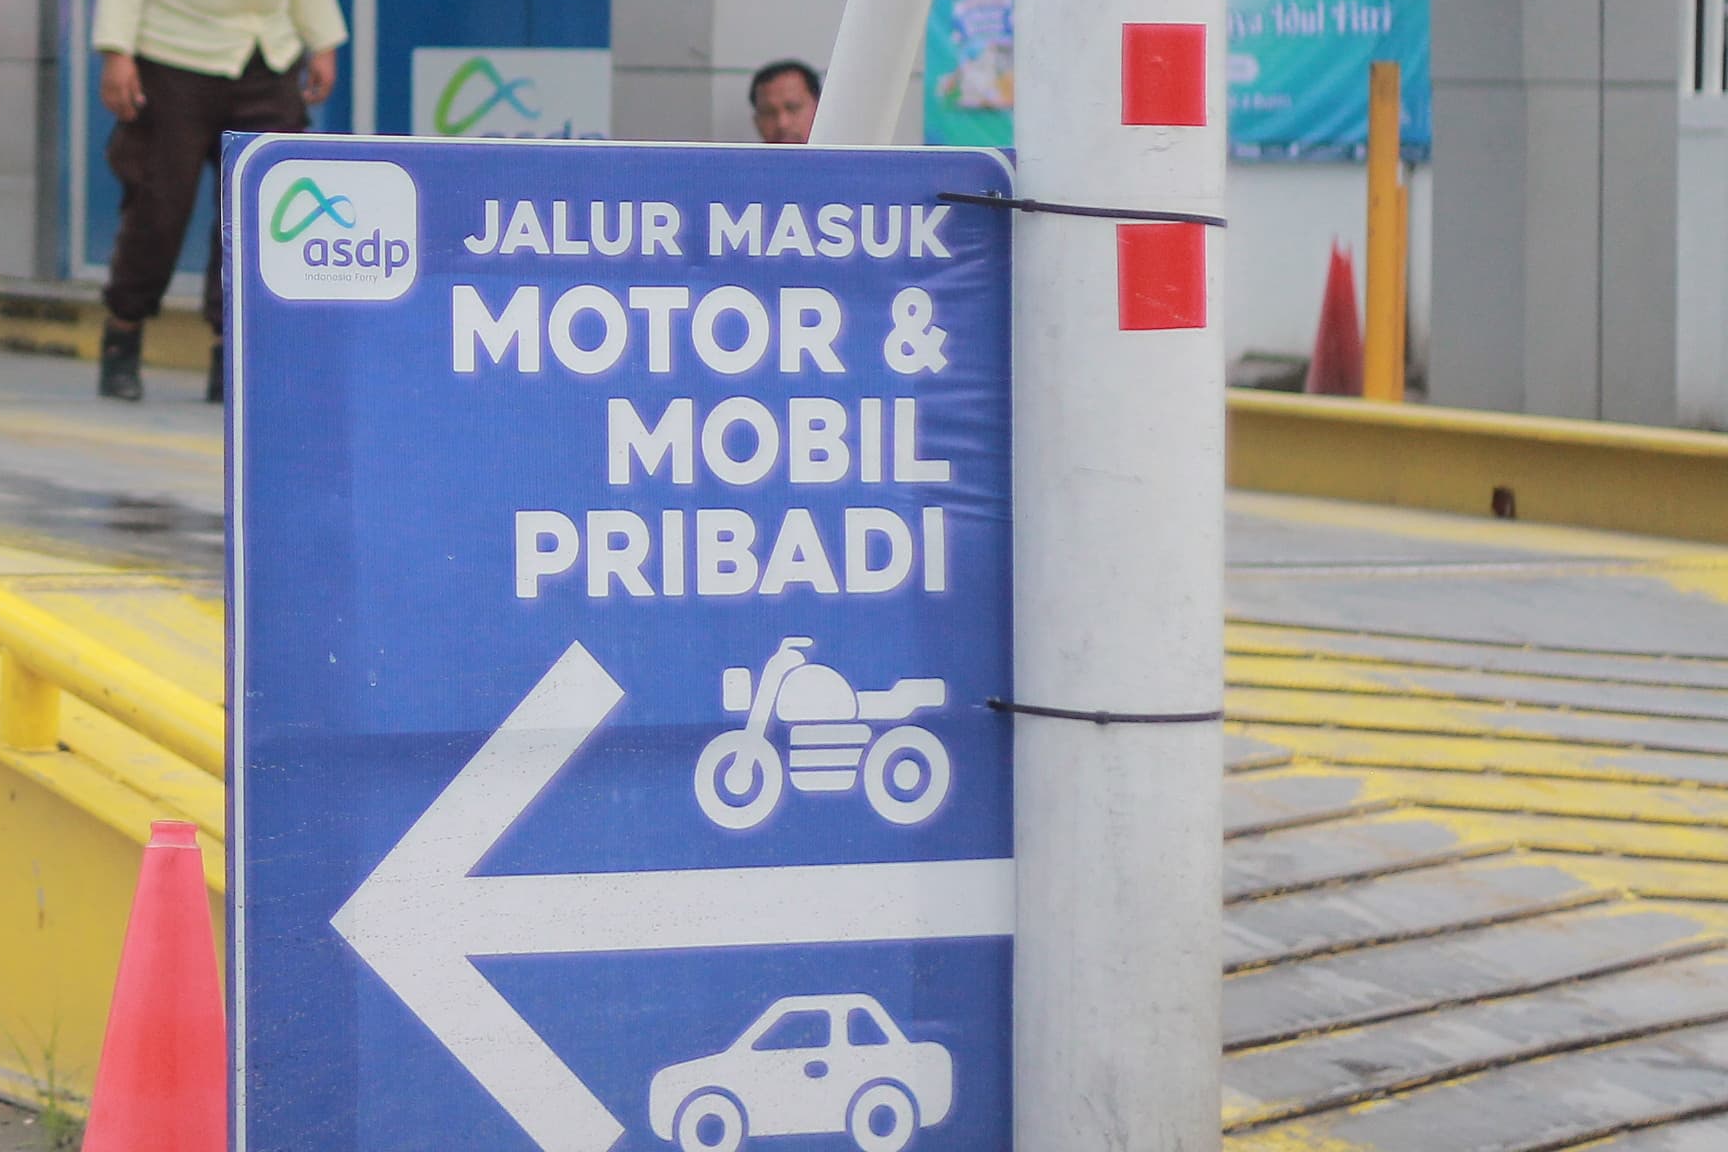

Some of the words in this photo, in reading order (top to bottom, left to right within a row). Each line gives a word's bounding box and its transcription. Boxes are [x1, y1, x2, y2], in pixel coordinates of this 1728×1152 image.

[1274, 0, 1325, 35] Idul
[303, 228, 410, 279] asdp
[463, 200, 683, 256] JALUR
[708, 202, 953, 259] MASUK
[304, 272, 353, 282] Indonesia
[354, 273, 379, 285] Ferry
[452, 284, 847, 375] MOTOR
[883, 286, 949, 375] &
[607, 396, 952, 485] MOBIL
[515, 506, 946, 598] PRIBADI
